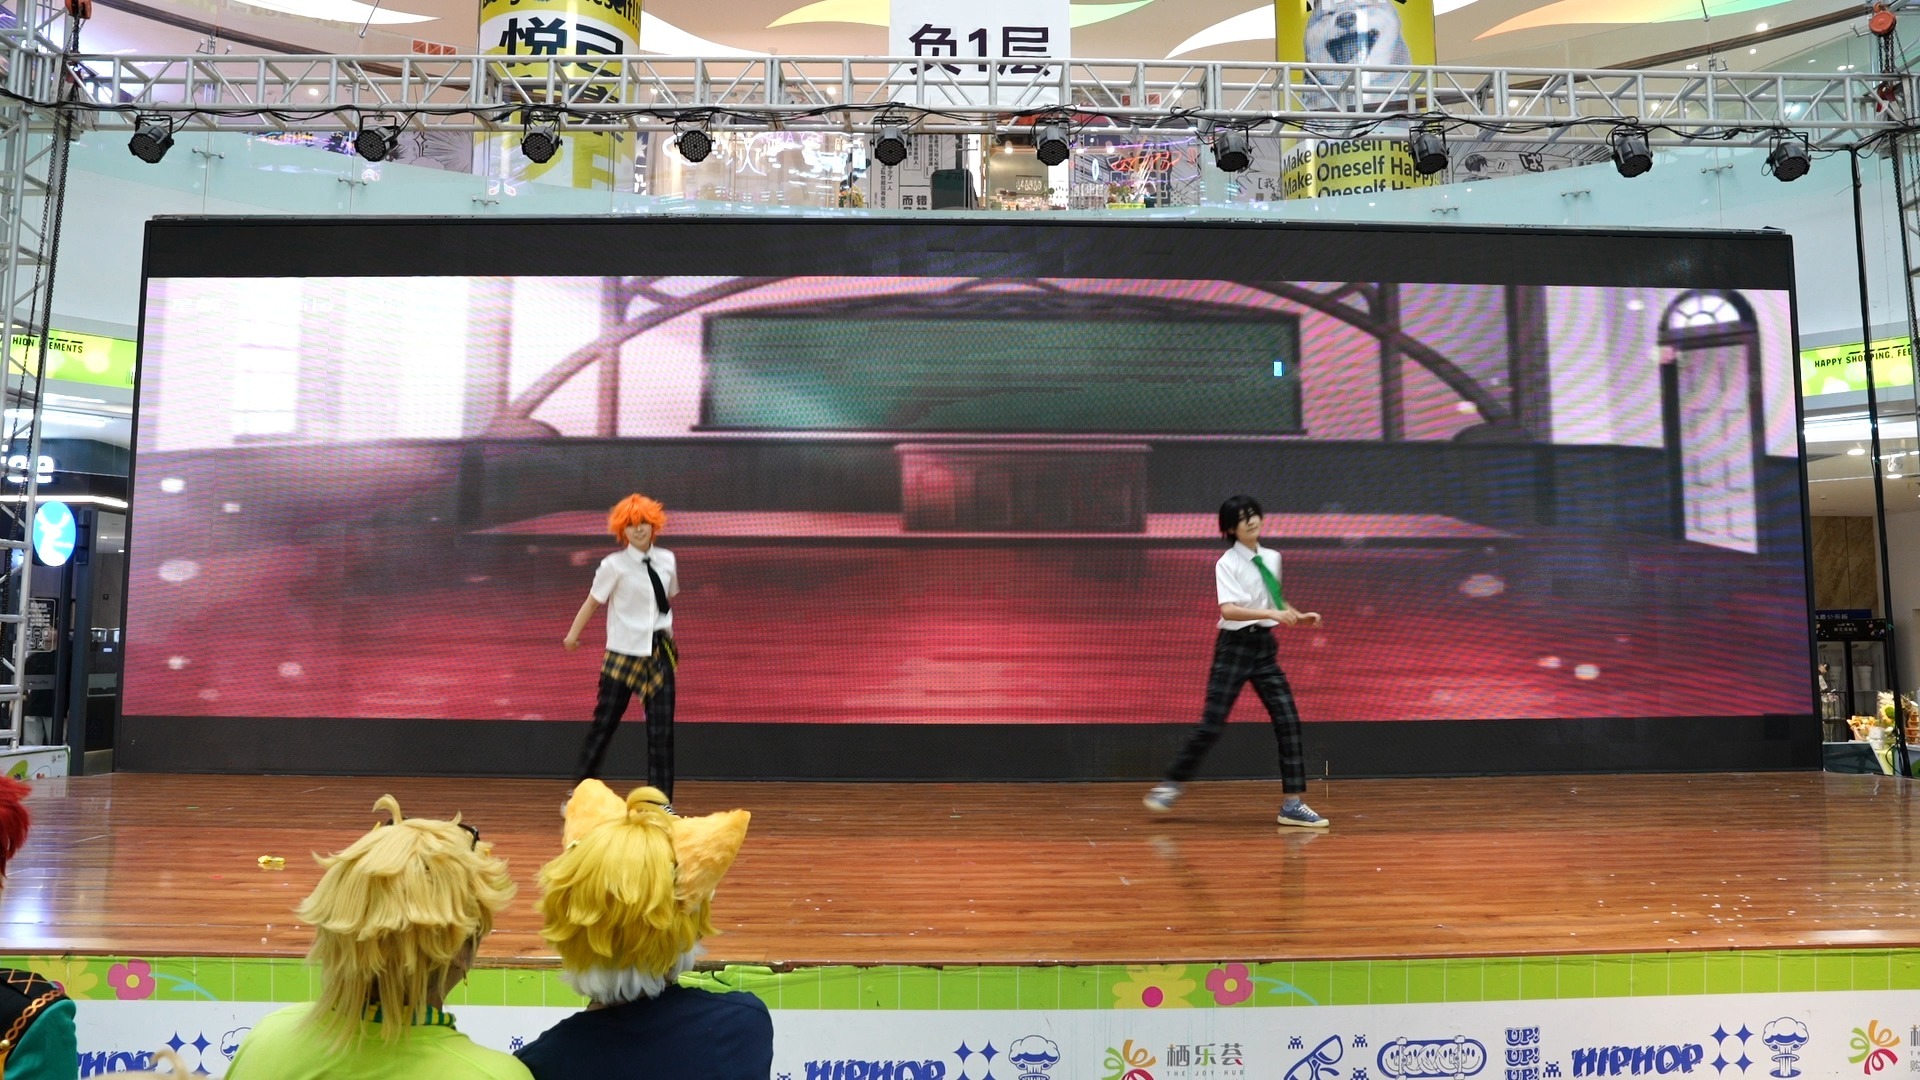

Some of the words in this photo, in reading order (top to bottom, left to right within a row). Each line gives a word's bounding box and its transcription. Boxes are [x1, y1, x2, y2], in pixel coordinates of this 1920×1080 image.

[908, 23, 1052, 76] 负1层
[1283, 150, 1312, 176] Make
[1284, 172, 1313, 197] Make
[1317, 156, 1385, 182] Oneself
[48, 341, 83, 354] EMENTS
[1814, 357, 1843, 368] HAPPY
[1897, 348, 1912, 358] FEE
[1504, 1025, 1541, 1046] UP!
[1166, 1043, 1243, 1067] 栖乐荟
[1504, 1046, 1541, 1066] UP!
[1571, 1043, 1704, 1078] HIPHOP
[804, 1059, 946, 1080] HIPHOP
